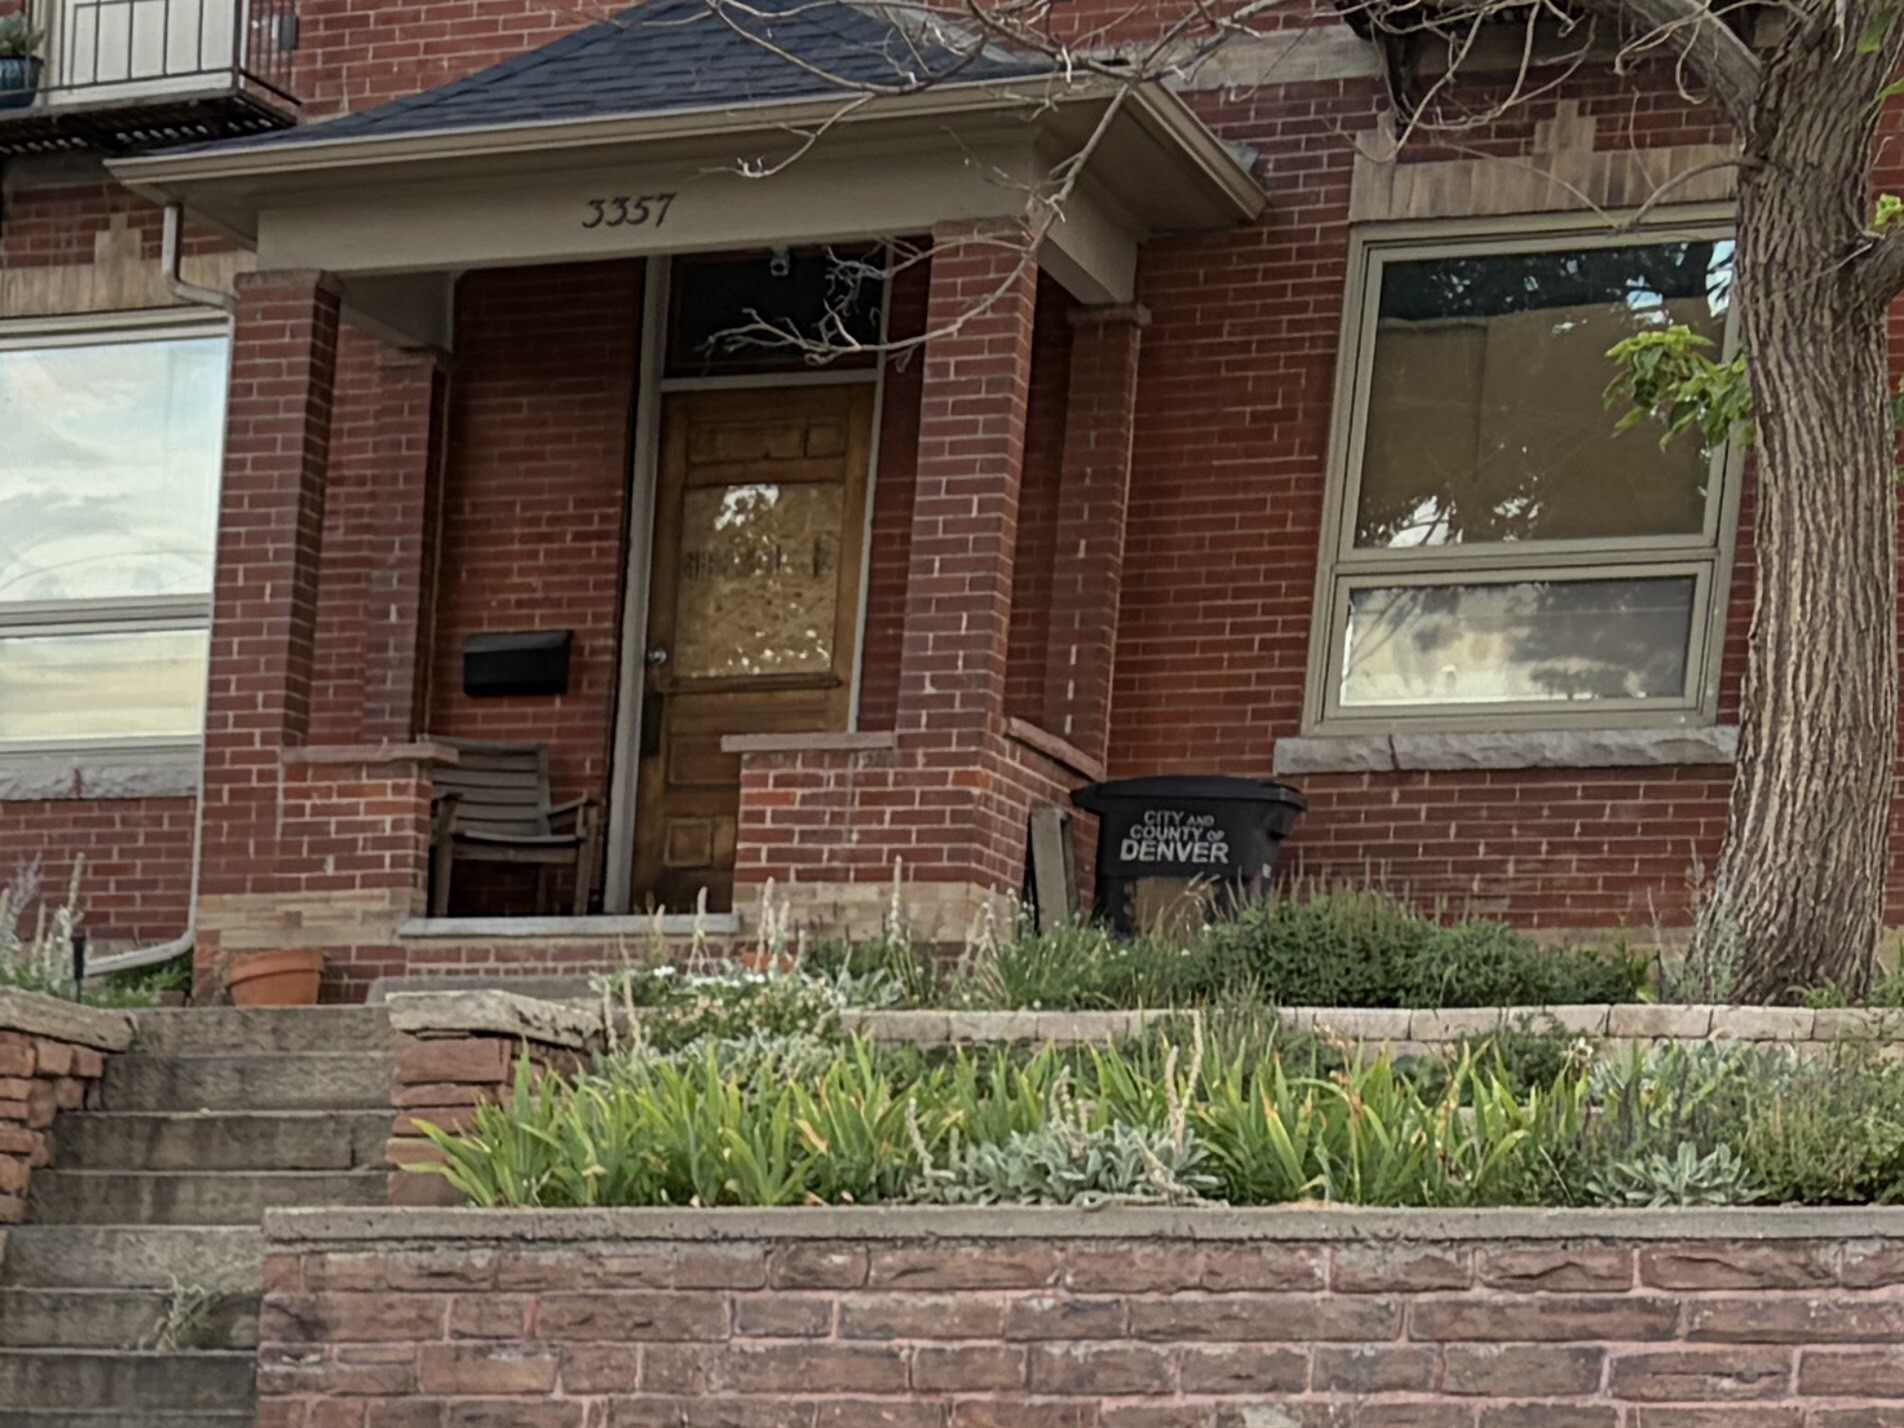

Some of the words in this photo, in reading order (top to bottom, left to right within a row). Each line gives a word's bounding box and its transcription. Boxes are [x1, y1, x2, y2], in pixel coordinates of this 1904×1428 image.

[582, 192, 677, 228] 3357
[1144, 810, 1185, 826] CITY
[1187, 814, 1214, 827] AND
[1130, 824, 1204, 842] COUNTY
[1206, 829, 1225, 842] OF
[1120, 839, 1229, 864] DENVER
